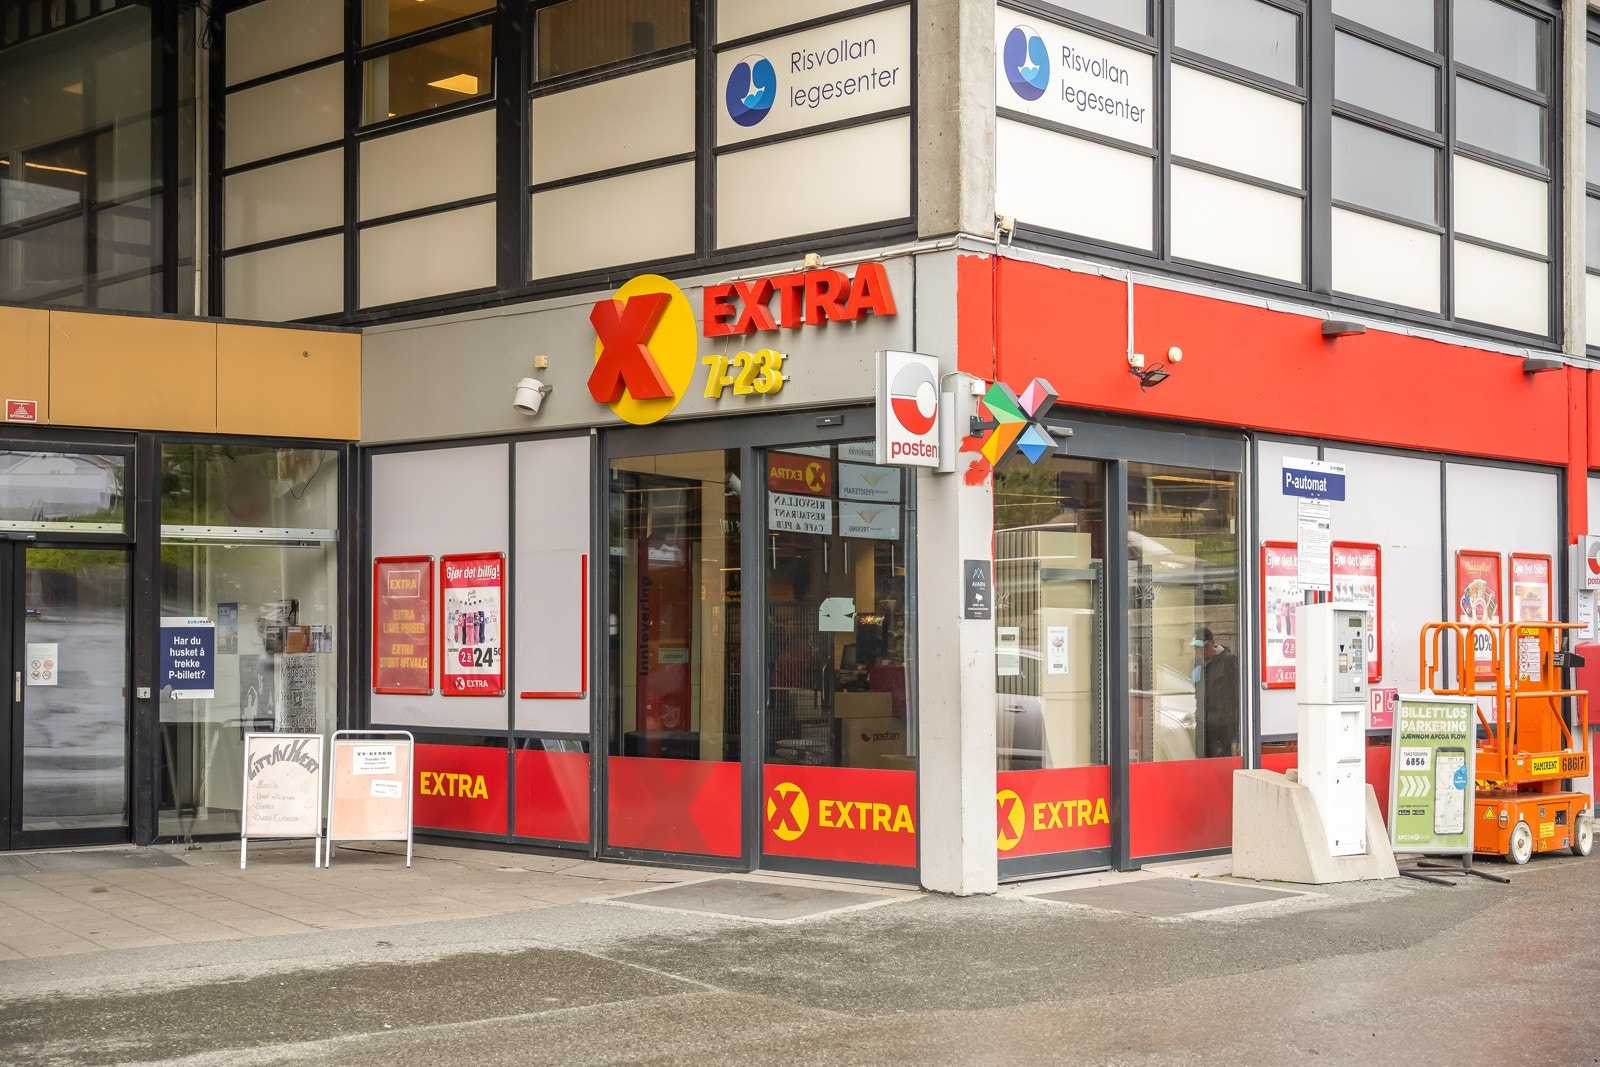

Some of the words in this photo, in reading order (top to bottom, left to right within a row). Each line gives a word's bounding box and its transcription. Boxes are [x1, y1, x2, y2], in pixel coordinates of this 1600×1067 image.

[790, 36, 876, 74] Risvollan
[1061, 45, 1129, 87] Risvollan
[790, 64, 899, 109] legesenter
[1061, 79, 1146, 124] legesenter
[703, 262, 897, 338] EXTRA
[702, 348, 783, 399] 7-23
[891, 441, 938, 459] posten
[1285, 473, 1327, 492] P-automat
[446, 566, 463, 582] Gjør
[464, 566, 476, 579] det
[477, 564, 500, 580] billig!
[390, 578, 417, 590] EXTRA
[1588, 577, 1600, 587] post
[392, 609, 416, 621] EXTRA
[173, 636, 188, 645] Har
[190, 636, 201, 645] du
[170, 647, 198, 657] husket
[200, 647, 205, 656] å
[391, 643, 414, 655] EXTRA
[174, 659, 200, 668] trekke
[460, 652, 466, 663] 2
[474, 648, 493, 667] 24
[168, 670, 206, 680] P-billett?
[1285, 672, 1296, 680] EXT
[467, 679, 489, 688] EXTRA
[1375, 693, 1382, 711] P
[1401, 706, 1467, 720] BILLETTLØS
[1401, 720, 1467, 733] PARKERING
[872, 730, 900, 744] posten
[1405, 757, 1425, 766] 6856
[1533, 760, 1557, 772] RAMIRENT
[420, 771, 489, 799] EXTRA
[819, 800, 915, 834] EXTRA
[1033, 798, 1110, 831] EXTRA
